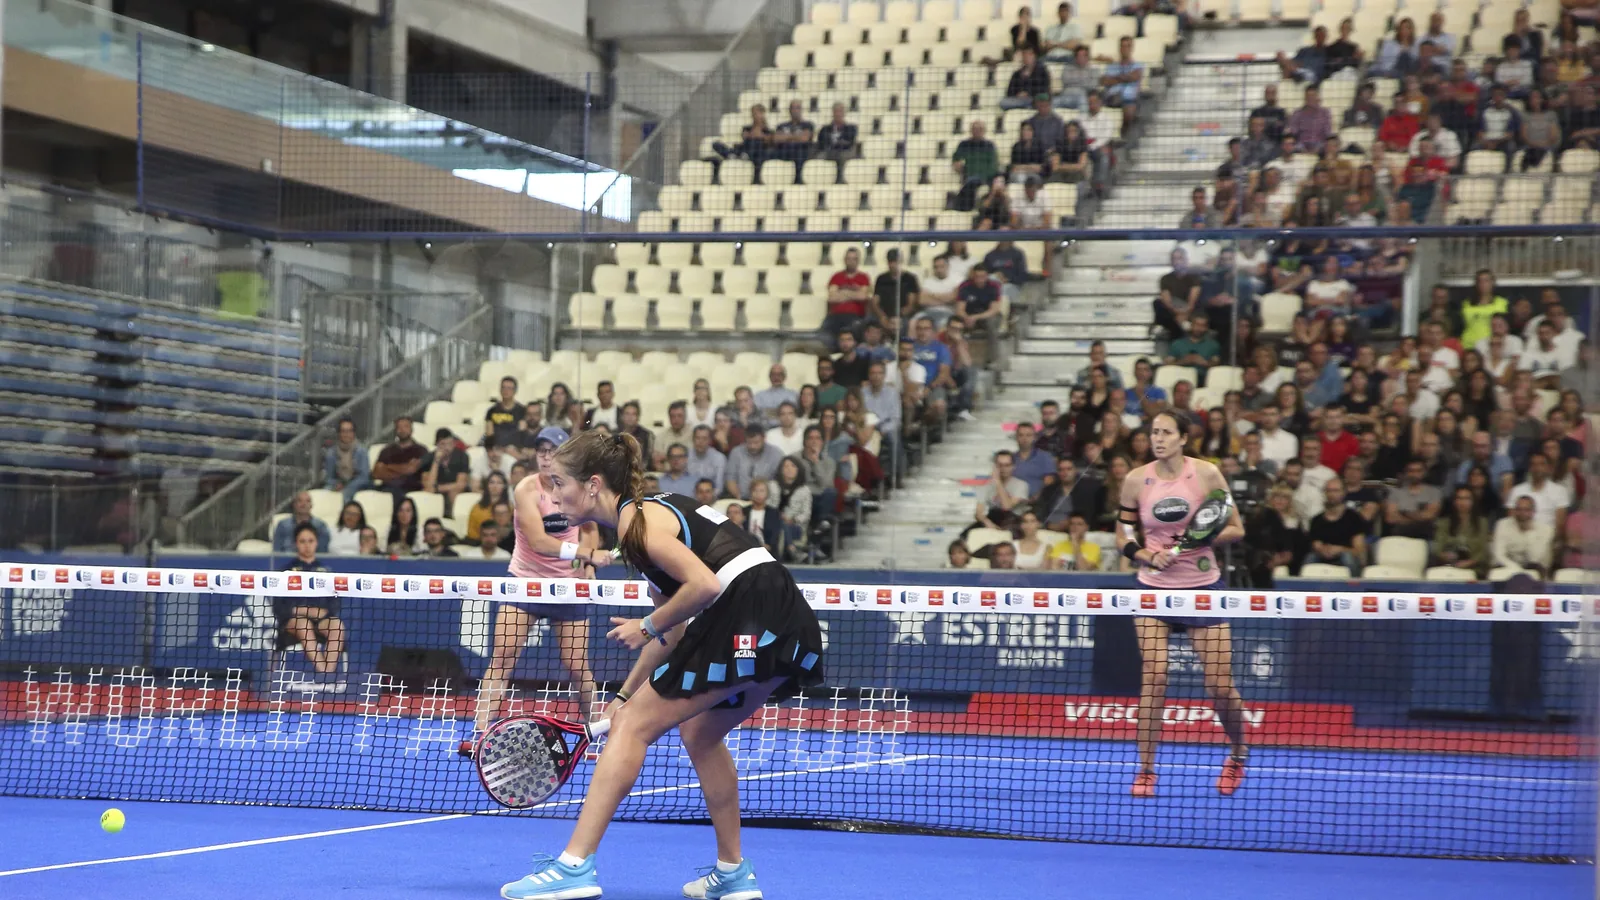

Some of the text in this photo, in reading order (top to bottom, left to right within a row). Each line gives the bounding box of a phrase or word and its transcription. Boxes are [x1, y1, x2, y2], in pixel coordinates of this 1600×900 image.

[212, 623, 279, 652] adid
[941, 612, 1095, 648] ESTRELL
[23, 665, 316, 752] WORLD
[1161, 704, 1266, 728] OPN
